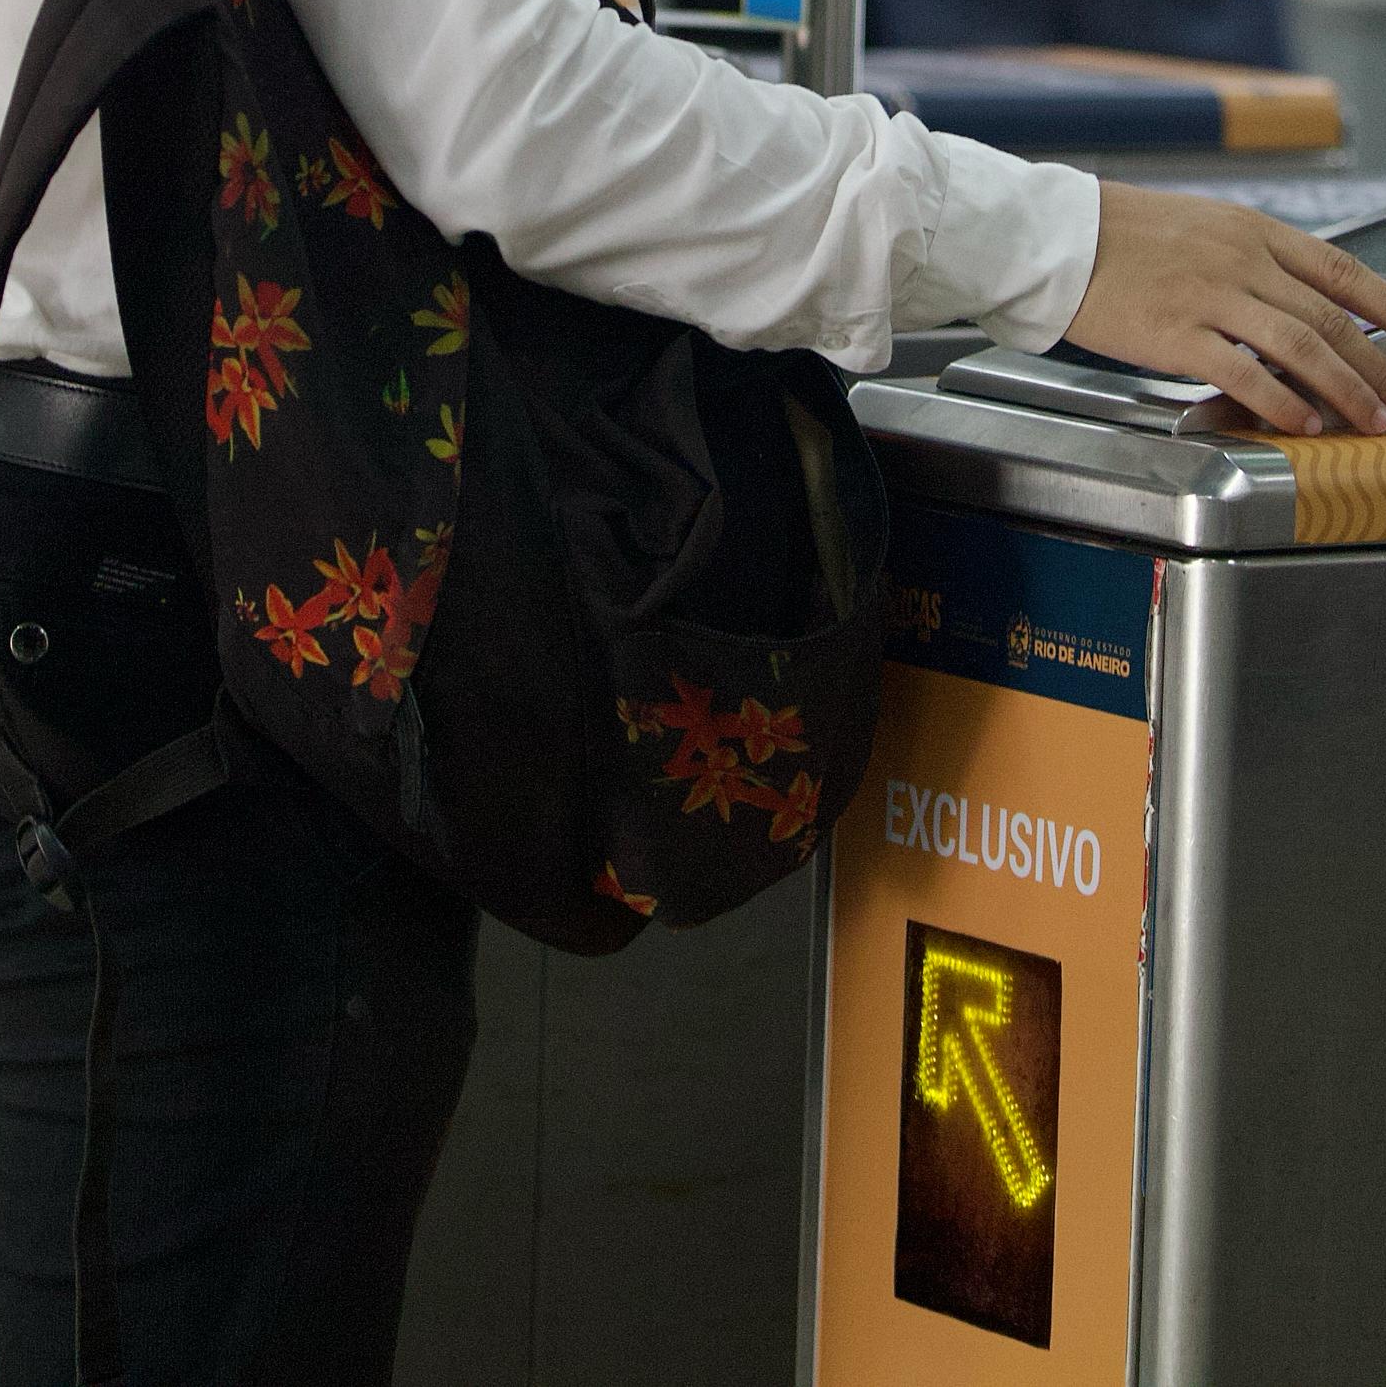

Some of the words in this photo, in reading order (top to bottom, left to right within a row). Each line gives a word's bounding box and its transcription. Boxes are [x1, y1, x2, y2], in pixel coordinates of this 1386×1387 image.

[1034, 626, 1077, 646] GOVERNO
[1080, 637, 1093, 648] DO
[1096, 640, 1131, 658] ESTADO
[1034, 639, 1056, 660] RIO
[1058, 645, 1075, 665] DE
[1077, 651, 1131, 678] JANEIRO
[885, 778, 1101, 897] EXCLUSIVO
